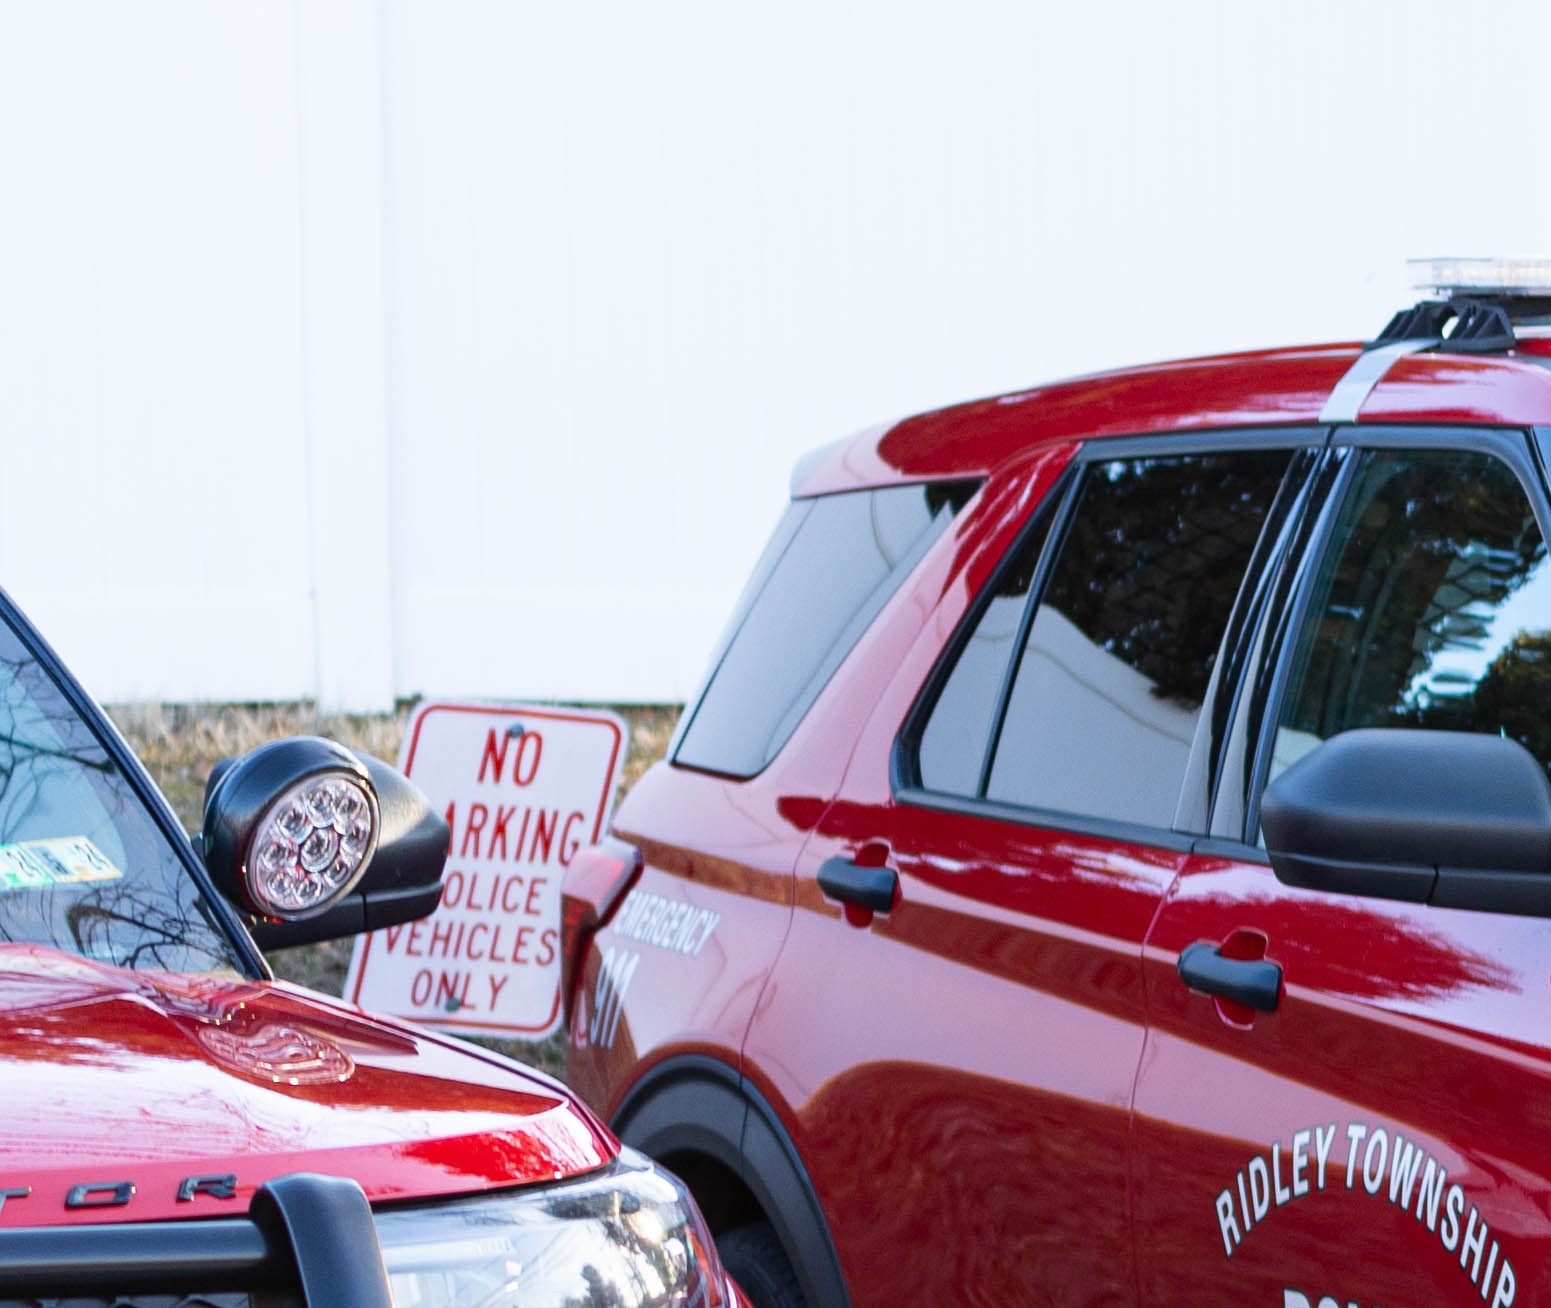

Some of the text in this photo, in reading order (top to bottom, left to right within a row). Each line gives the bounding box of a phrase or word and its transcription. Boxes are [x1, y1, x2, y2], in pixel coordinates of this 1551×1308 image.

[477, 727, 544, 787] NO
[445, 800, 585, 867] ARKING
[442, 871, 548, 915] OLICE
[613, 888, 721, 955] EMERGENCY
[386, 917, 558, 966] VEHICLES
[410, 969, 509, 1011] ONLY
[590, 945, 640, 1049] 911
[1215, 1122, 1337, 1258] RIDLEY
